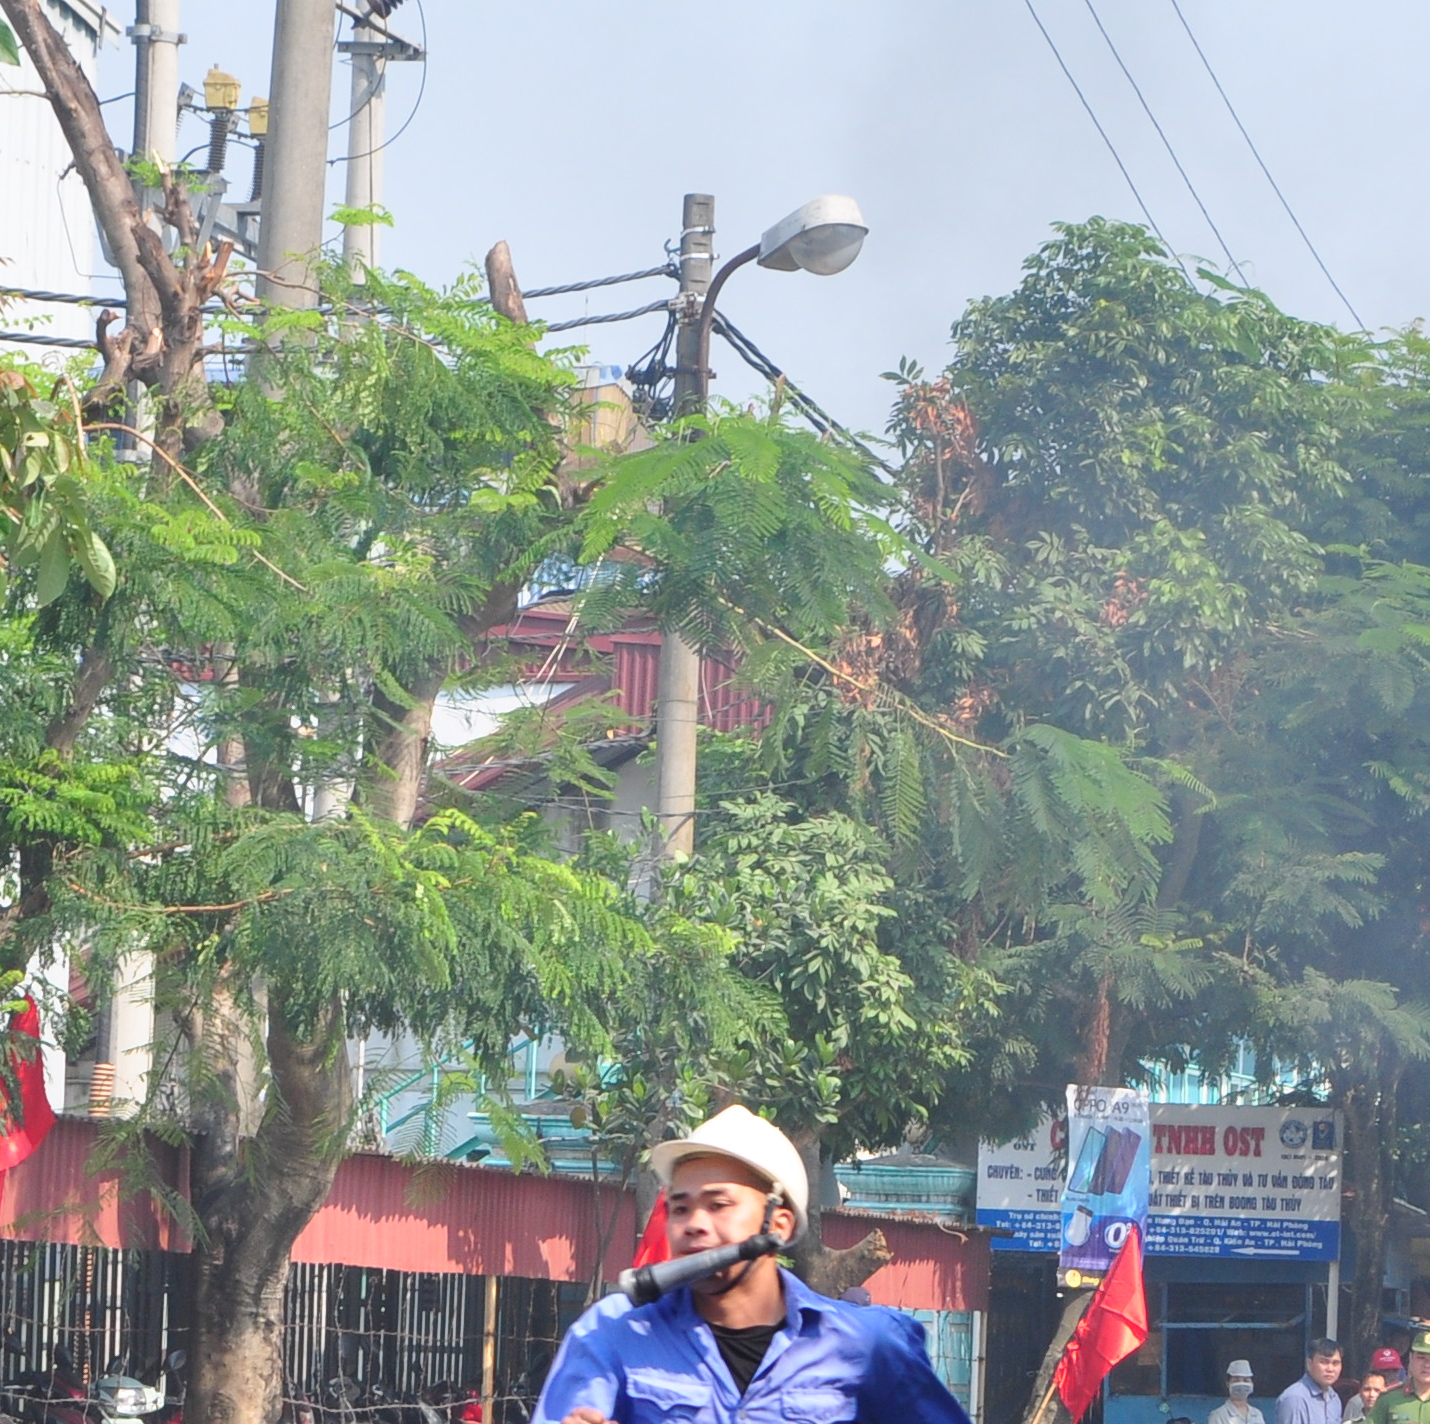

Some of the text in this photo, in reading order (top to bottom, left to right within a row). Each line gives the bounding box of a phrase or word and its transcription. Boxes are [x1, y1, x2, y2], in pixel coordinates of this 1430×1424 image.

[1112, 1101, 1129, 1114] A9
[1152, 1124, 1216, 1156] TNHH
[1223, 1126, 1265, 1157] OST
